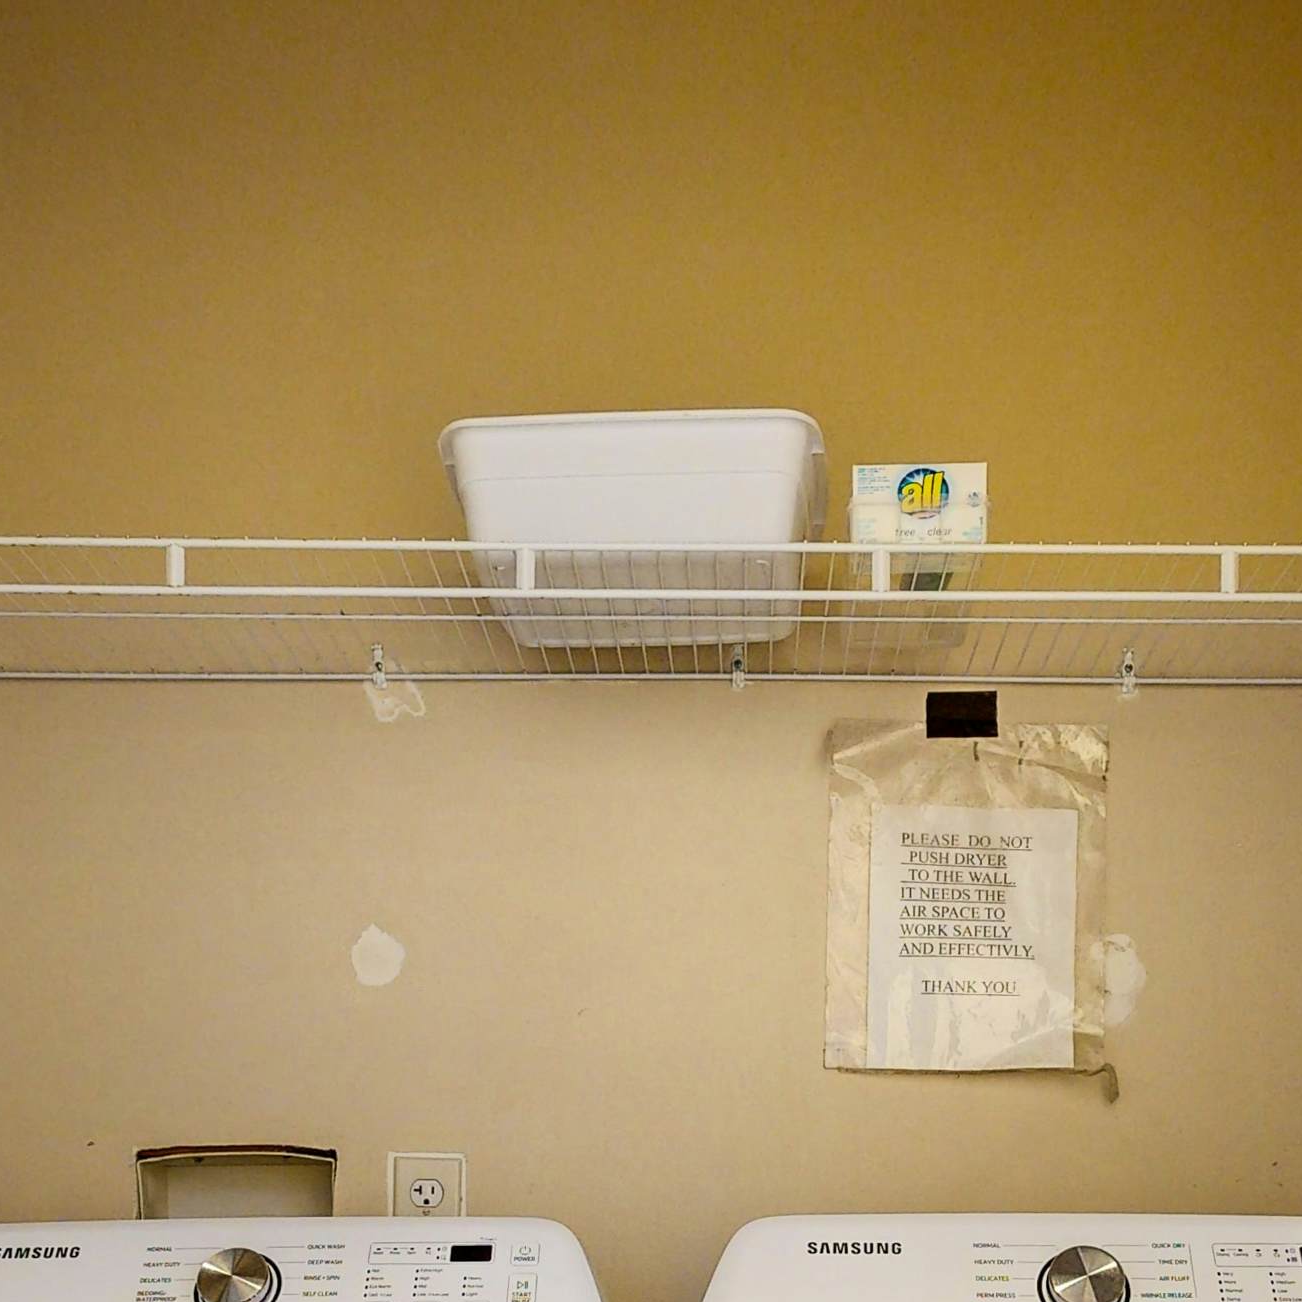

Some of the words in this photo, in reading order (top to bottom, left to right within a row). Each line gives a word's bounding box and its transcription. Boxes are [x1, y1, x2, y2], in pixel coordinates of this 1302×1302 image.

[900, 471, 945, 514] all
[927, 527, 953, 537] clear
[902, 832, 960, 846] PLEASE
[969, 835, 991, 848] DO
[1000, 836, 1033, 849] NOT
[910, 850, 949, 864] PUSH
[955, 853, 1007, 866] DRYER
[908, 868, 929, 881] TO
[933, 870, 964, 882] THE
[969, 871, 1016, 885] WALL.
[901, 887, 916, 898] IT
[920, 887, 971, 900] NEEDS
[975, 889, 1006, 902] THE
[900, 905, 927, 917] AIR
[932, 906, 980, 918] SPACE
[985, 907, 1006, 920] TO
[900, 924, 948, 936] WORK
[953, 925, 1012, 938] SAFELY
[900, 943, 934, 954] AND
[921, 980, 977, 993] THANK
[982, 981, 1017, 994] YOU
[807, 1241, 903, 1255] SAMSUNG
